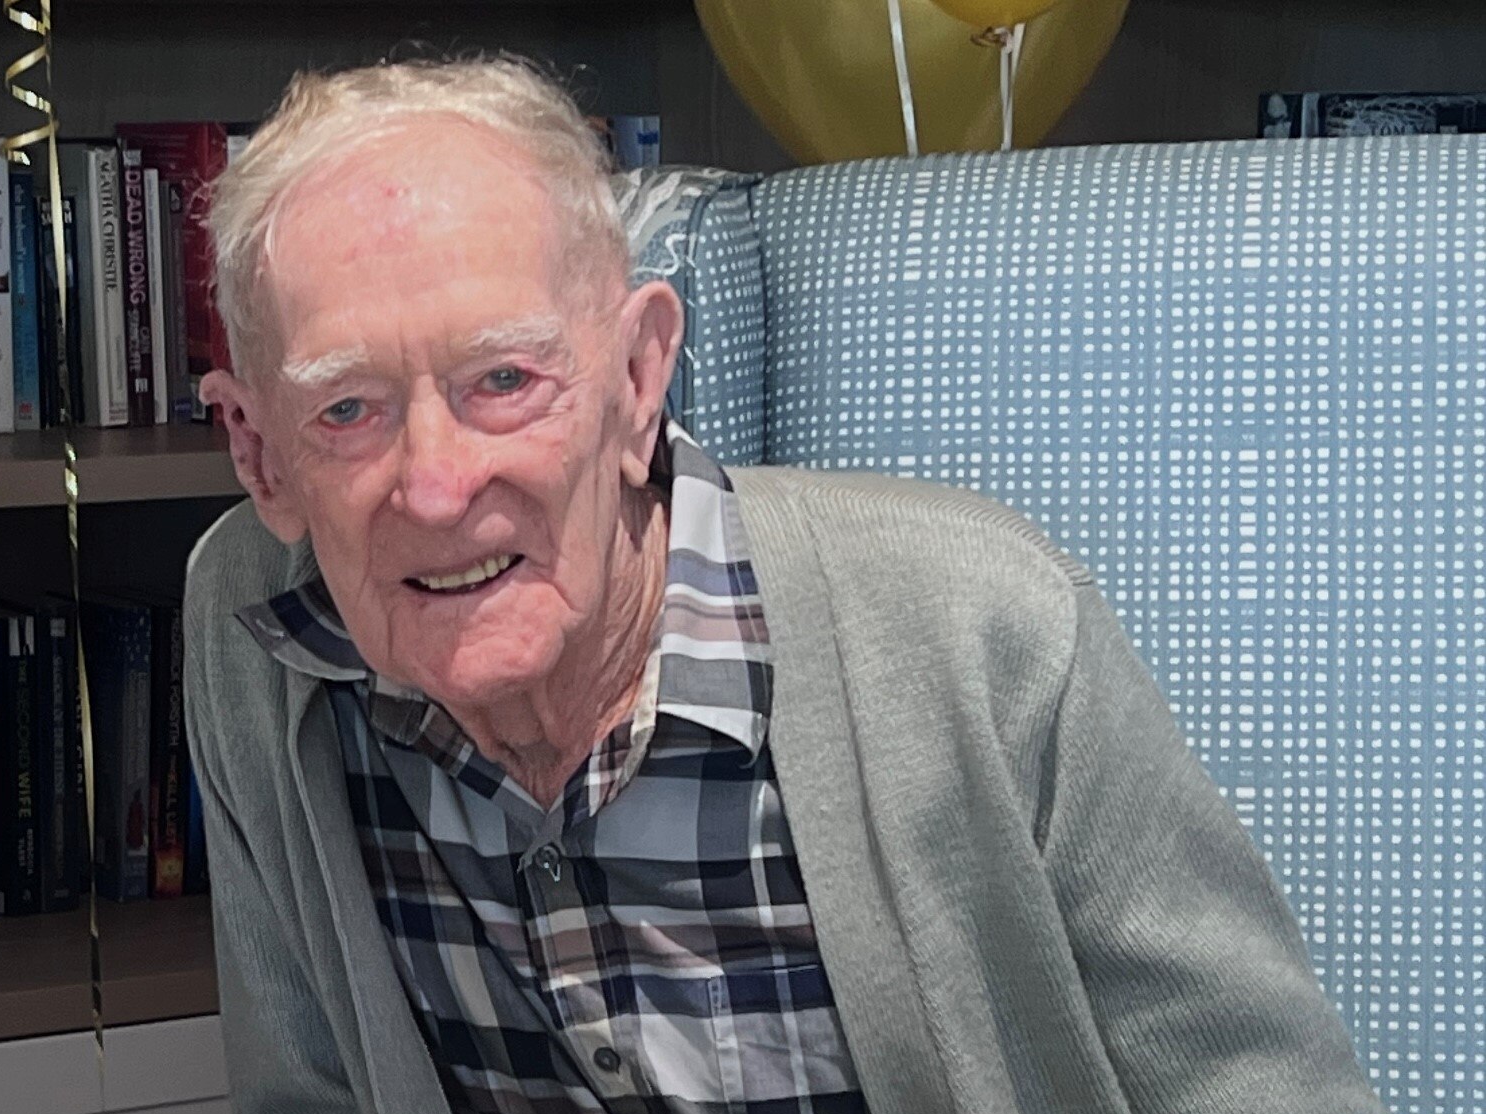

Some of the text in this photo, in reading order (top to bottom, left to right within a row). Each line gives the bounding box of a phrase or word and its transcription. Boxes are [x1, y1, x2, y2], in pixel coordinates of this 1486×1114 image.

[100, 161, 118, 293] AGATHA CHRISTIE
[125, 170, 146, 305] DEAD WRONG
[17, 686, 30, 769] SECOND
[169, 684, 182, 746] FORSYTH
[17, 771, 32, 818] WIFE
